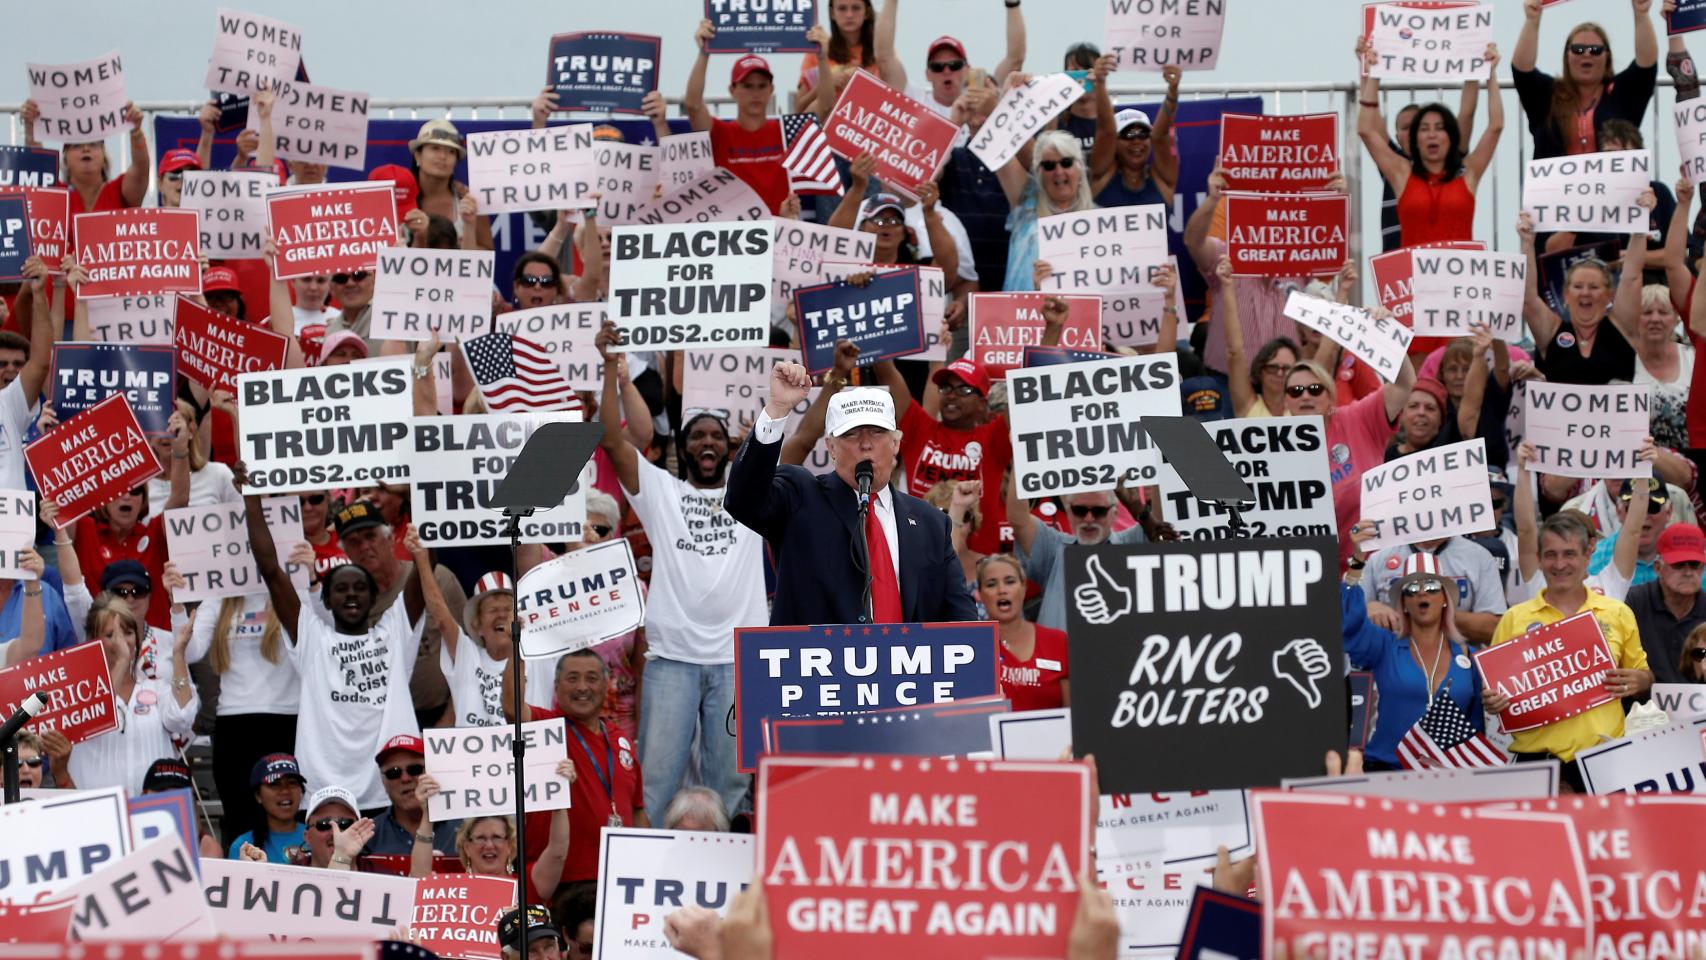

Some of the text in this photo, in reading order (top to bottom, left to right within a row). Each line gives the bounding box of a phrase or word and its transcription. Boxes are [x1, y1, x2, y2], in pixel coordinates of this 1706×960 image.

[711, 0, 812, 12] TRUMP
[1112, 0, 1222, 16] WOMEN
[720, 13, 804, 24] PENCE
[1379, 11, 1491, 31] WOMEN
[220, 16, 302, 51] WOMEN
[1142, 25, 1181, 38] FOR
[1113, 48, 1213, 65] TRUMP
[1411, 39, 1452, 51] FOR
[246, 49, 276, 66] FOR
[554, 55, 653, 73] TRUMP
[1382, 56, 1484, 73] TRUMP
[28, 55, 123, 88] WOMEN
[217, 67, 291, 98] TRUMP
[560, 72, 642, 85] PENCE
[60, 94, 100, 109] FOR
[285, 116, 325, 132] FOR
[879, 101, 917, 128] MAKE
[996, 87, 1073, 160] TRUMP
[1008, 98, 1036, 132] FOR
[472, 131, 591, 157] WOMEN
[837, 101, 938, 169] AMERICA
[1261, 129, 1301, 141] MAKE
[661, 140, 711, 162] WOMEN
[835, 125, 924, 180] GREAT AGAIN
[1223, 145, 1335, 163] AMERICA
[510, 162, 552, 176] FOR
[672, 171, 694, 184] FOR
[1230, 168, 1328, 179] GREAT AGAIN
[1529, 157, 1648, 178] WOMEN
[480, 181, 589, 205] TRUMP
[597, 178, 632, 192] FOR
[1564, 183, 1606, 195] FOR
[640, 170, 736, 225] WOMEN
[205, 209, 245, 221] FOR
[311, 203, 353, 217] MAKE
[1266, 210, 1307, 221] MAKE
[1534, 206, 1643, 224] TRUMP
[115, 222, 158, 236] MAKE
[276, 216, 394, 246] AMERICA
[1043, 212, 1164, 240] WOMEN
[1230, 225, 1345, 244] AMERICA
[81, 240, 197, 264] AMERICA
[286, 241, 387, 261] GREAT AGAIN
[616, 228, 769, 260] BLACKS
[1080, 245, 1122, 258] FOR
[1237, 248, 1338, 262] GREAT AGAIN
[87, 265, 190, 282] GREAT AGAIN
[382, 256, 492, 278] WOMEN
[667, 263, 713, 282] FOR
[1052, 266, 1163, 289] TRUMP
[1417, 258, 1524, 280] WOMEN
[124, 296, 165, 310] FOR
[415, 288, 455, 302] FOR
[614, 283, 766, 317] TRUMP
[1454, 286, 1492, 299] FOR
[382, 311, 485, 333] TRUMP
[805, 293, 914, 328] TRUMP
[1330, 309, 1368, 334] FOR
[1425, 310, 1515, 330] TRUMP
[208, 324, 245, 347] MAKE
[616, 322, 764, 346] GODS2.com
[816, 325, 908, 350] MAKE GREAT AGAIN!
[818, 313, 904, 341] PENCE
[1297, 306, 1393, 370] TRUMP
[176, 325, 275, 372] AMERICA
[182, 349, 217, 382] GREAT
[59, 368, 170, 388] TRUMP
[244, 368, 407, 406] BLACKS
[1013, 361, 1174, 405] BLACKS
[66, 388, 159, 402] PENCE
[841, 399, 886, 410] MAKE AMERICA
[1531, 390, 1648, 412] WOMEN
[301, 405, 350, 424] FOR
[844, 407, 864, 416] GREAT
[1071, 401, 1120, 423] FOR
[61, 424, 98, 454] MAKE
[247, 422, 408, 461] TRUMP
[1018, 421, 1154, 463] TRUM
[1567, 424, 1611, 438] FOR
[42, 426, 143, 495] AMERICA
[922, 446, 981, 470] TRUMP
[1536, 445, 1643, 468] TRUMP
[55, 471, 100, 508] GREAT
[100, 450, 145, 488] AGAIN
[249, 463, 411, 488] GODS2.com
[1235, 460, 1270, 478] OR
[1365, 446, 1484, 492] WOMEN
[1399, 485, 1442, 504] FOR
[169, 504, 300, 537] WOMEN
[419, 519, 581, 541] GODS2.com
[1375, 503, 1485, 539] TRUMP
[518, 568, 627, 611] TRUMP
[1126, 549, 1322, 614] TRUMP
[528, 590, 621, 624] PENCE
[528, 610, 601, 634] MAKE AMERICA GREAT
[760, 644, 974, 677] TRUMP
[1129, 632, 1242, 685] RNC
[1522, 638, 1564, 662] MAKE
[24, 667, 68, 690] MAKE
[361, 661, 388, 676] Not
[1497, 644, 1609, 699] AMERICA
[781, 682, 955, 707] PENCE
[1509, 670, 1608, 717] GREAT AGAIN
[62, 702, 106, 730] AGAIN
[1111, 686, 1270, 728] BOLTERS
[428, 725, 564, 755] WOMEN
[440, 781, 561, 810] TRUMP
[870, 793, 977, 826] MAKE
[1131, 803, 1219, 825] GREAT AGAIN!
[1367, 828, 1474, 864] MAKE
[766, 835, 1077, 893] AMERICA
[1115, 860, 1153, 873] 2016
[71, 849, 192, 942] MEN
[206, 876, 396, 926] TRUMP
[422, 887, 468, 900] MAKE
[1147, 899, 1190, 908] AGAIN!
[1277, 867, 1585, 928] AMERICA
[787, 897, 1057, 936] GREAT AGAIN
[441, 928, 498, 944] AGAIN
[624, 939, 656, 947] MAKE
[1300, 931, 1567, 960] GREAT AGAIN
